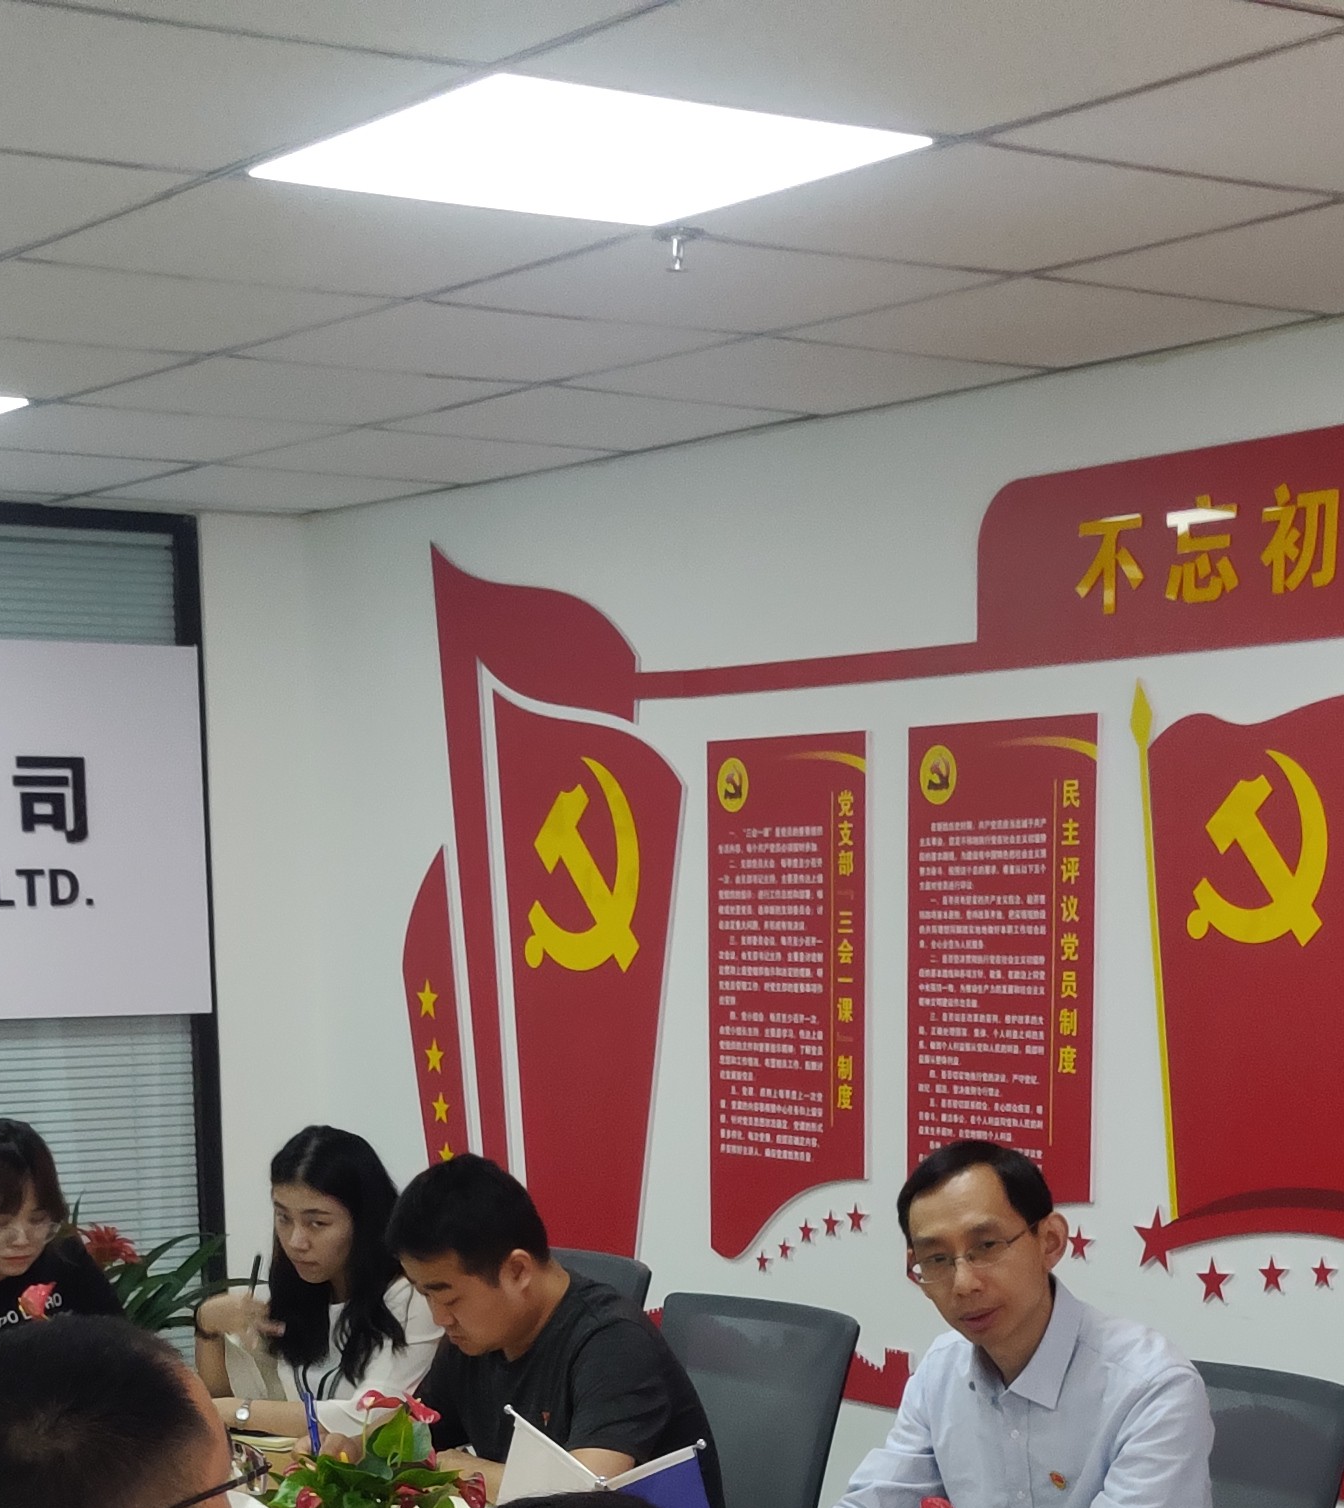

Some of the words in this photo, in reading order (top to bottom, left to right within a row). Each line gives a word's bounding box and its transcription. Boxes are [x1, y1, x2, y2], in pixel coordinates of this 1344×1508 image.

[1057, 778, 1081, 1075] 民主评议党员制度
